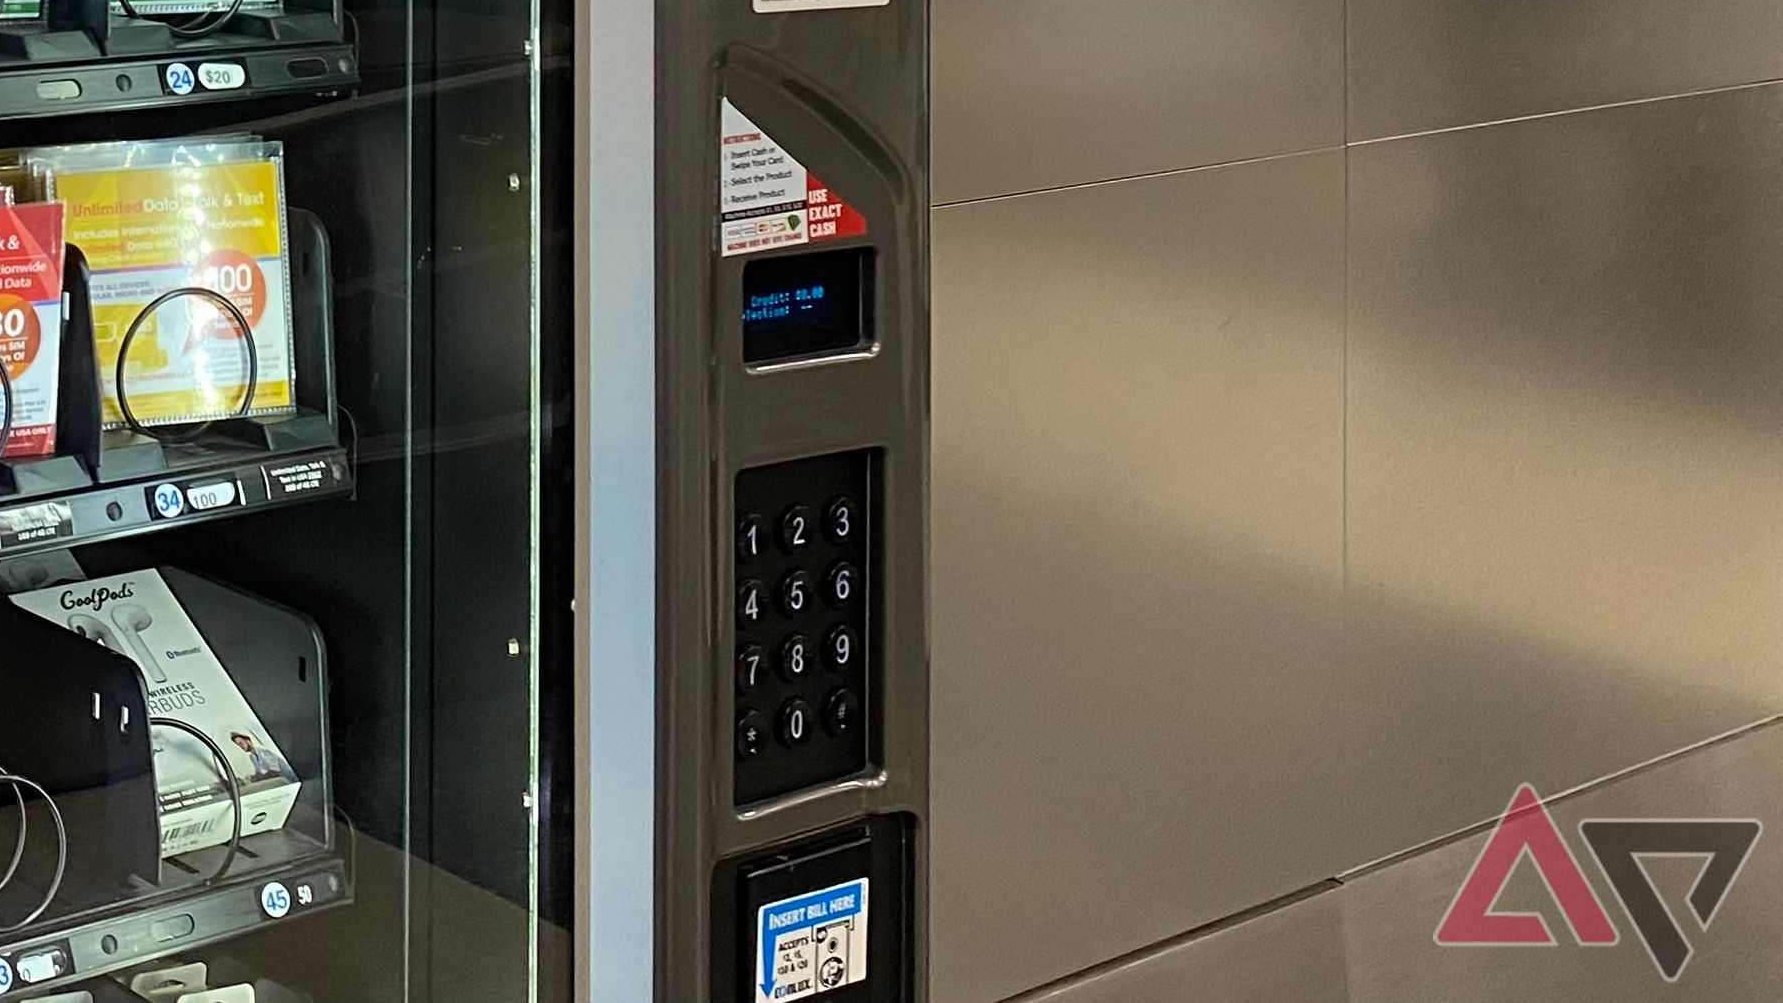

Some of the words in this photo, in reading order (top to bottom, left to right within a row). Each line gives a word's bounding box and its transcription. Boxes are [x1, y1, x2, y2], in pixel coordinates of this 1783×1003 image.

[169, 69, 192, 88] 24
[205, 69, 230, 84] $20
[808, 189, 828, 204] USE
[809, 204, 842, 221] EXACT
[810, 221, 836, 237] CASH
[7, 235, 20, 250] &
[752, 293, 789, 307] Credit:
[158, 491, 181, 511] 34
[747, 524, 757, 555] 1
[792, 516, 805, 545] 2
[836, 507, 849, 537] 3
[745, 589, 759, 620] 4
[790, 581, 804, 610] 5
[836, 570, 851, 598] 6
[746, 656, 760, 686] 7
[792, 644, 804, 673] 8
[836, 634, 850, 664] 9
[149, 682, 195, 697] WIRELESS
[790, 709, 803, 739] 0
[266, 890, 288, 911] 45
[297, 884, 313, 905] 50
[769, 907, 805, 931] INSERT
[807, 901, 828, 919] BILL
[829, 894, 856, 914] HERE
